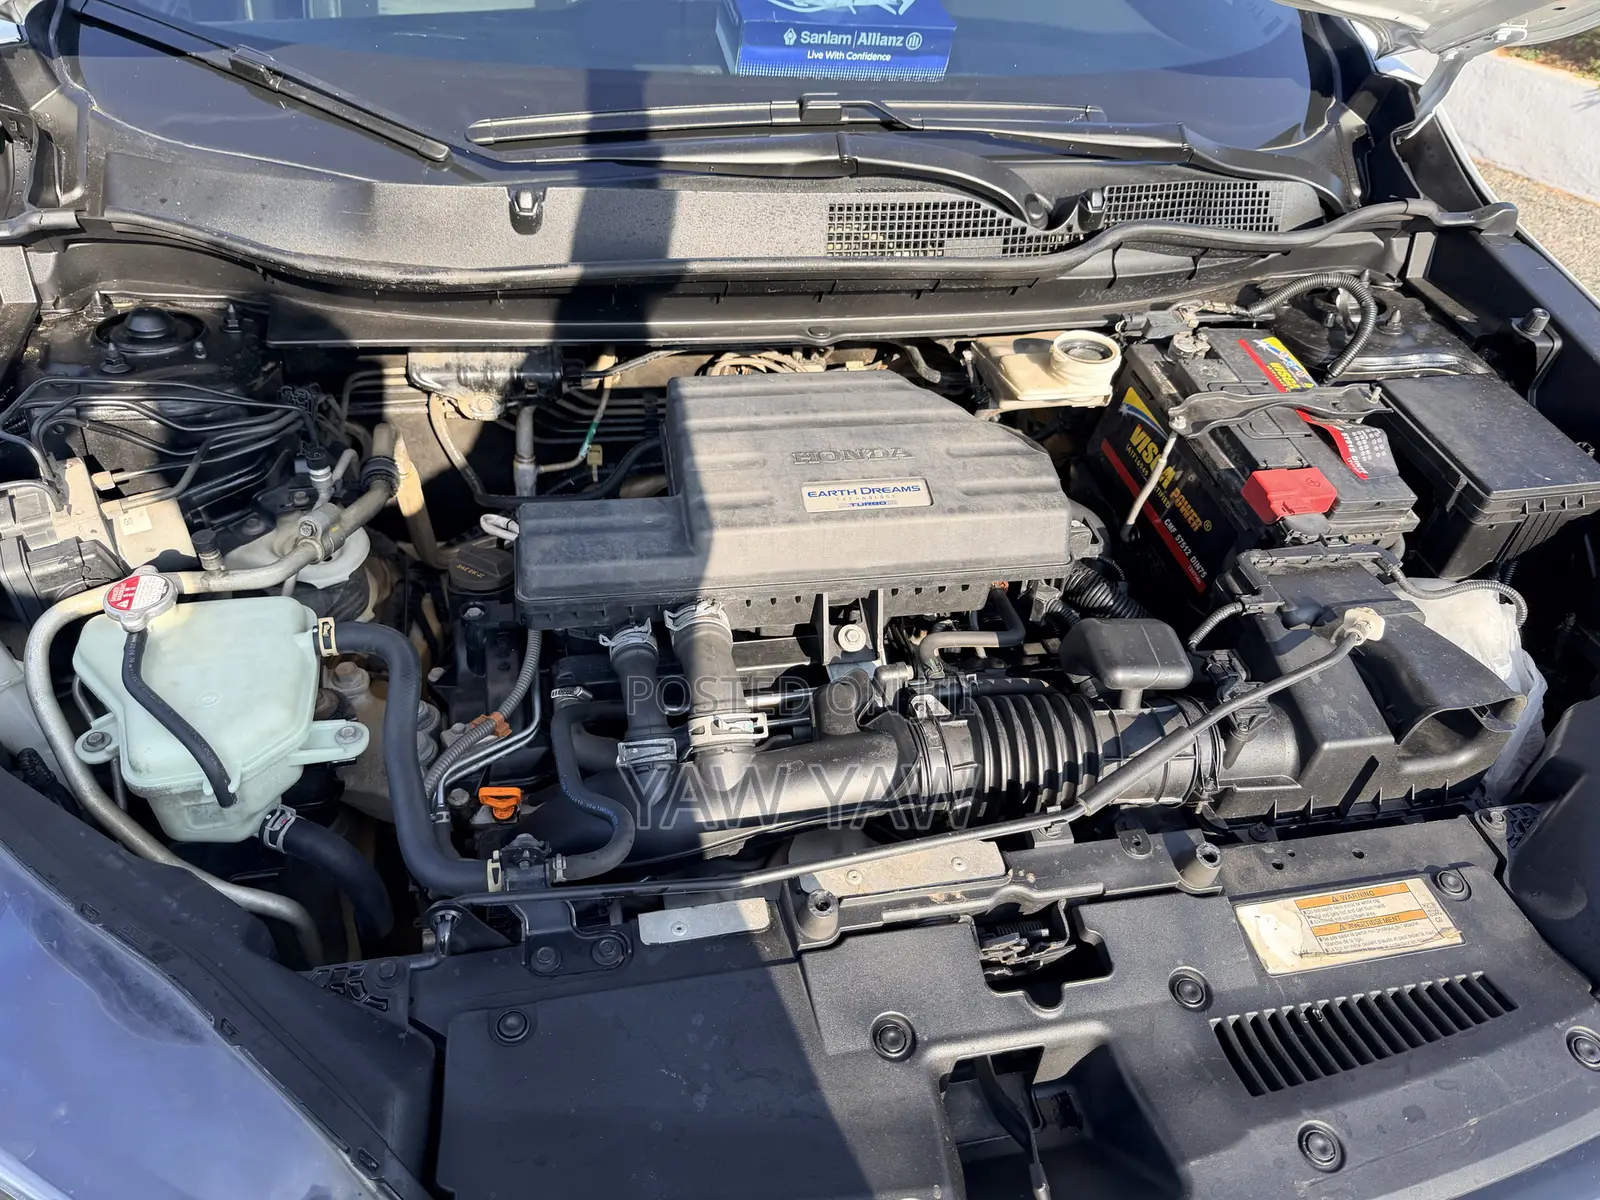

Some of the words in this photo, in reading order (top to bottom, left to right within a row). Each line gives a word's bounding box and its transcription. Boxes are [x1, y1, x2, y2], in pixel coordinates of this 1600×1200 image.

[800, 30, 851, 45] Sanlam
[857, 31, 904, 47] Allianz
[807, 50, 824, 60] Live
[825, 50, 844, 60] With
[846, 51, 891, 62] Confidence
[791, 447, 916, 465] HONDA
[807, 489, 857, 498] EARTH
[860, 485, 921, 495] DREAMS
[1169, 486, 1204, 532] POWER
[1164, 518, 1177, 534] CMF
[1175, 534, 1193, 559] 57512
[1190, 555, 1209, 578] DIN75
[1339, 890, 1376, 900] WARNING
[1346, 915, 1403, 928] AVERTISSEMENT
